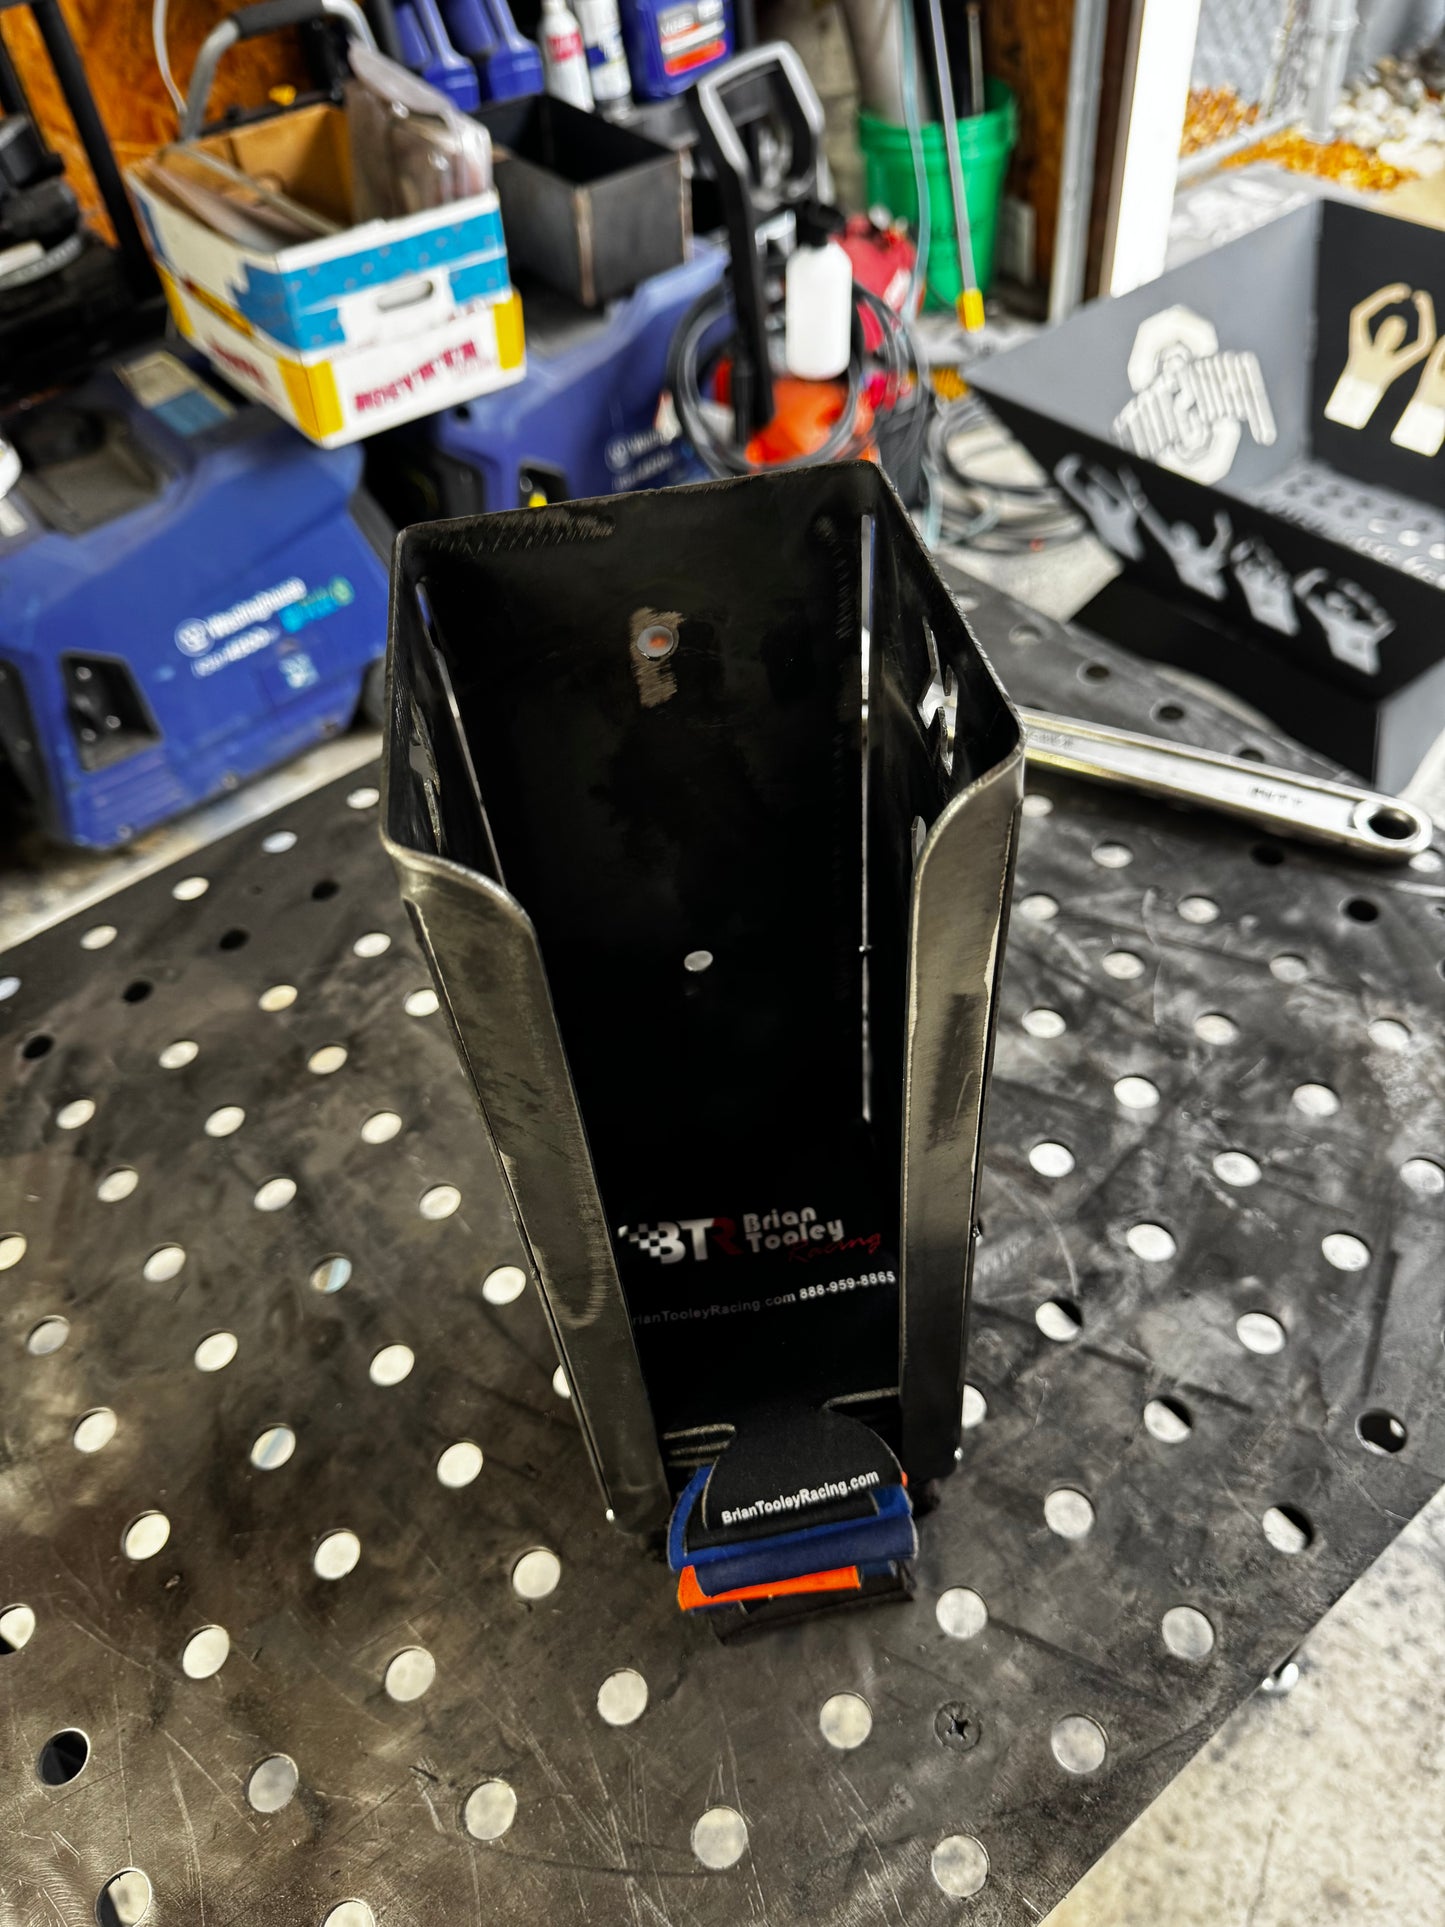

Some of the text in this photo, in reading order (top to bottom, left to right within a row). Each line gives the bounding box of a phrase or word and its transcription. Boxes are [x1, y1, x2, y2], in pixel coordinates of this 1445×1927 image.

[624, 1217, 744, 1264] BTR
[743, 1205, 817, 1234] Brian
[745, 1217, 845, 1254] Tooley
[787, 1231, 882, 1263] Racing
[632, 1270, 896, 1326] rianTooleyRacing.com 888-959-8865
[721, 1470, 880, 1525] BrianTooleyRacing.com
